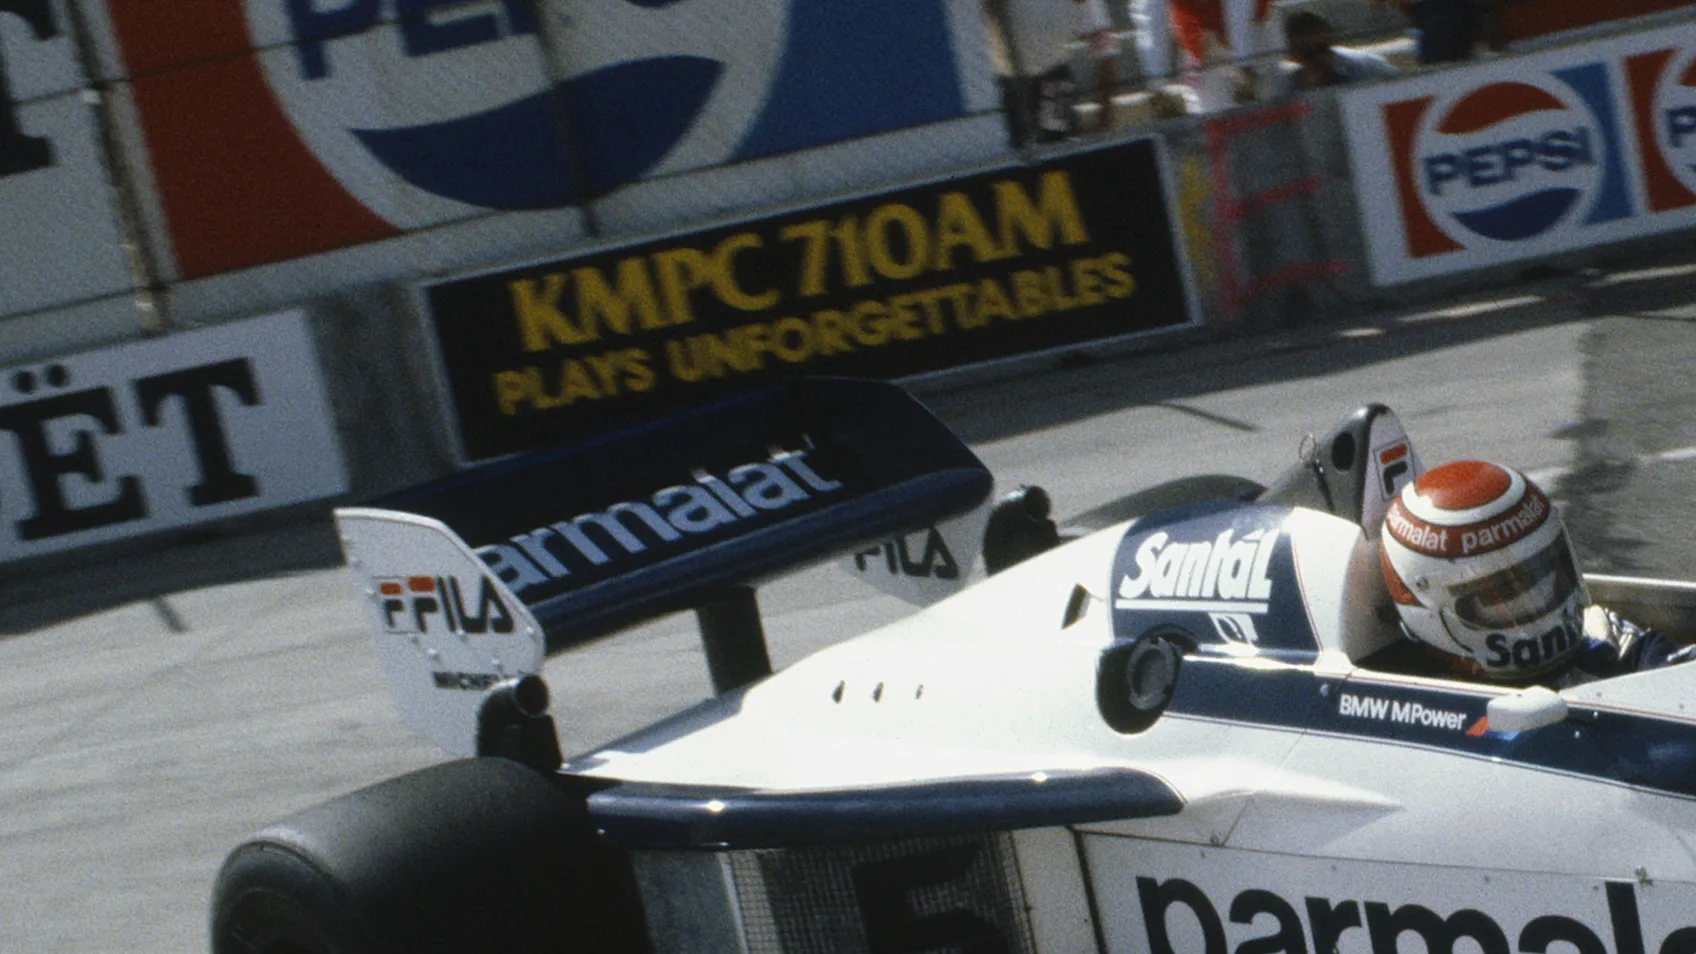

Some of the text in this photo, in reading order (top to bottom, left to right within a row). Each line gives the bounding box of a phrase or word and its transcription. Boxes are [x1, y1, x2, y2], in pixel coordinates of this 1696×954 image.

[1425, 126, 1592, 196] PEPSI
[508, 170, 1089, 352] KMPC 710AM
[492, 251, 1136, 415] PLAYS UNFORGETTABLES
[1461, 494, 1546, 553] parmalat
[407, 575, 516, 634] FILA
[1339, 694, 1390, 720] BMW
